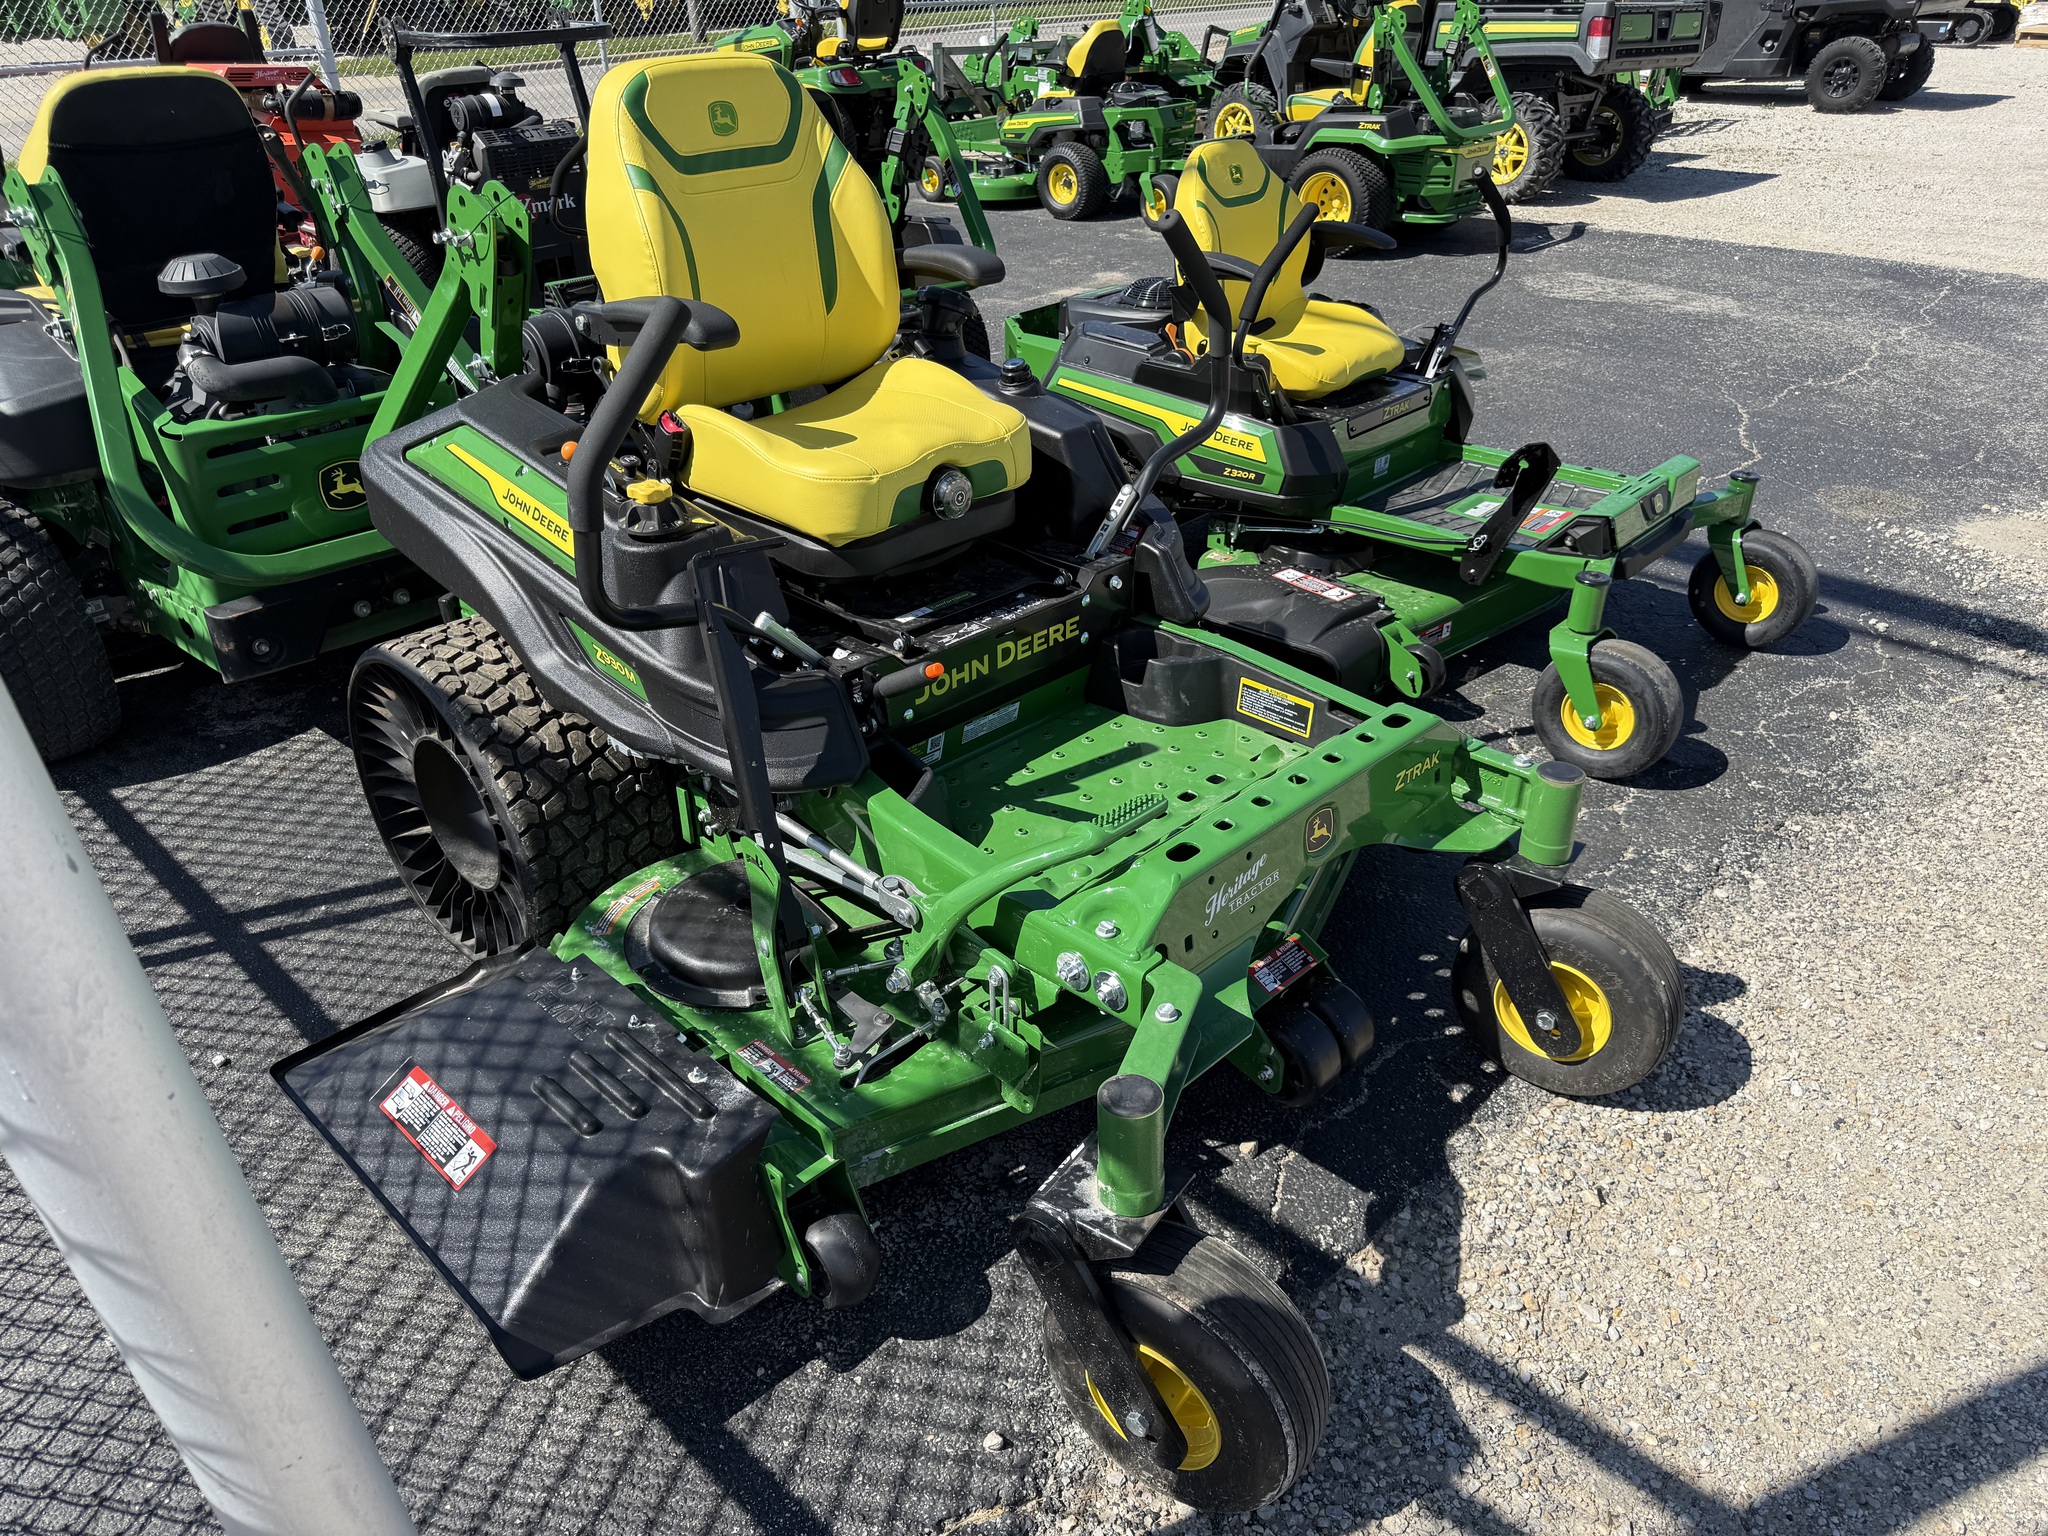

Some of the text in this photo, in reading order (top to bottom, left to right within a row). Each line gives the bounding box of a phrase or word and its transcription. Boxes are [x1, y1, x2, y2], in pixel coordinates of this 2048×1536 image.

[1358, 122, 1381, 130] ZTRAK
[1383, 400, 1410, 420] ZTRAK
[1213, 431, 1254, 451] DEERE
[1223, 467, 1256, 480] Z320R
[502, 488, 569, 542] JOHN DEERE
[593, 643, 637, 684] Z930M
[915, 615, 1080, 705] JOHN DEERE
[1394, 750, 1440, 792] ZTRAK
[1205, 854, 1267, 926] Heritage
[1229, 871, 1279, 912] TRACTOR
[527, 984, 597, 1041] REMOVE
[547, 974, 616, 1026] DO NOT
[428, 1084, 450, 1108] DANGER
[453, 1110, 476, 1134] PELIGRO
